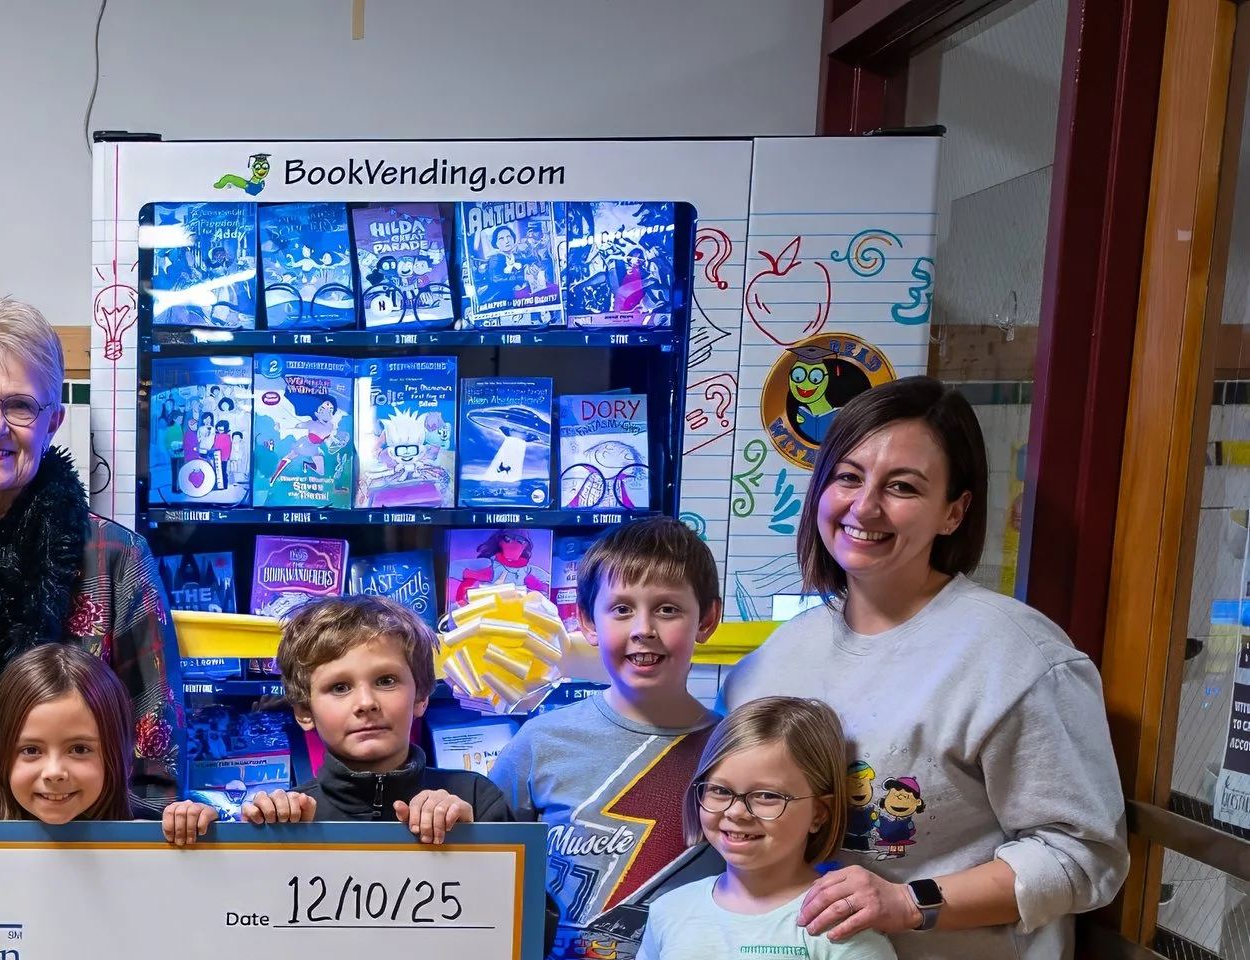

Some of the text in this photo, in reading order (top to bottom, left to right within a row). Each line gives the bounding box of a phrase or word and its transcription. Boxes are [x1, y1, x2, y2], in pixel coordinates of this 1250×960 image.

[284, 158, 566, 192] BookVending.com
[370, 220, 425, 237] HILDA
[373, 240, 429, 254] PARADE
[829, 339, 883, 373] READ
[269, 360, 278, 373] 2
[370, 364, 378, 375] 2
[581, 400, 641, 421] DORY
[263, 567, 333, 588] BOOKWANDERERS
[171, 588, 212, 603] THE
[547, 824, 635, 856] Muscle
[288, 875, 462, 924] 12/10/25
[226, 912, 270, 927] Date
